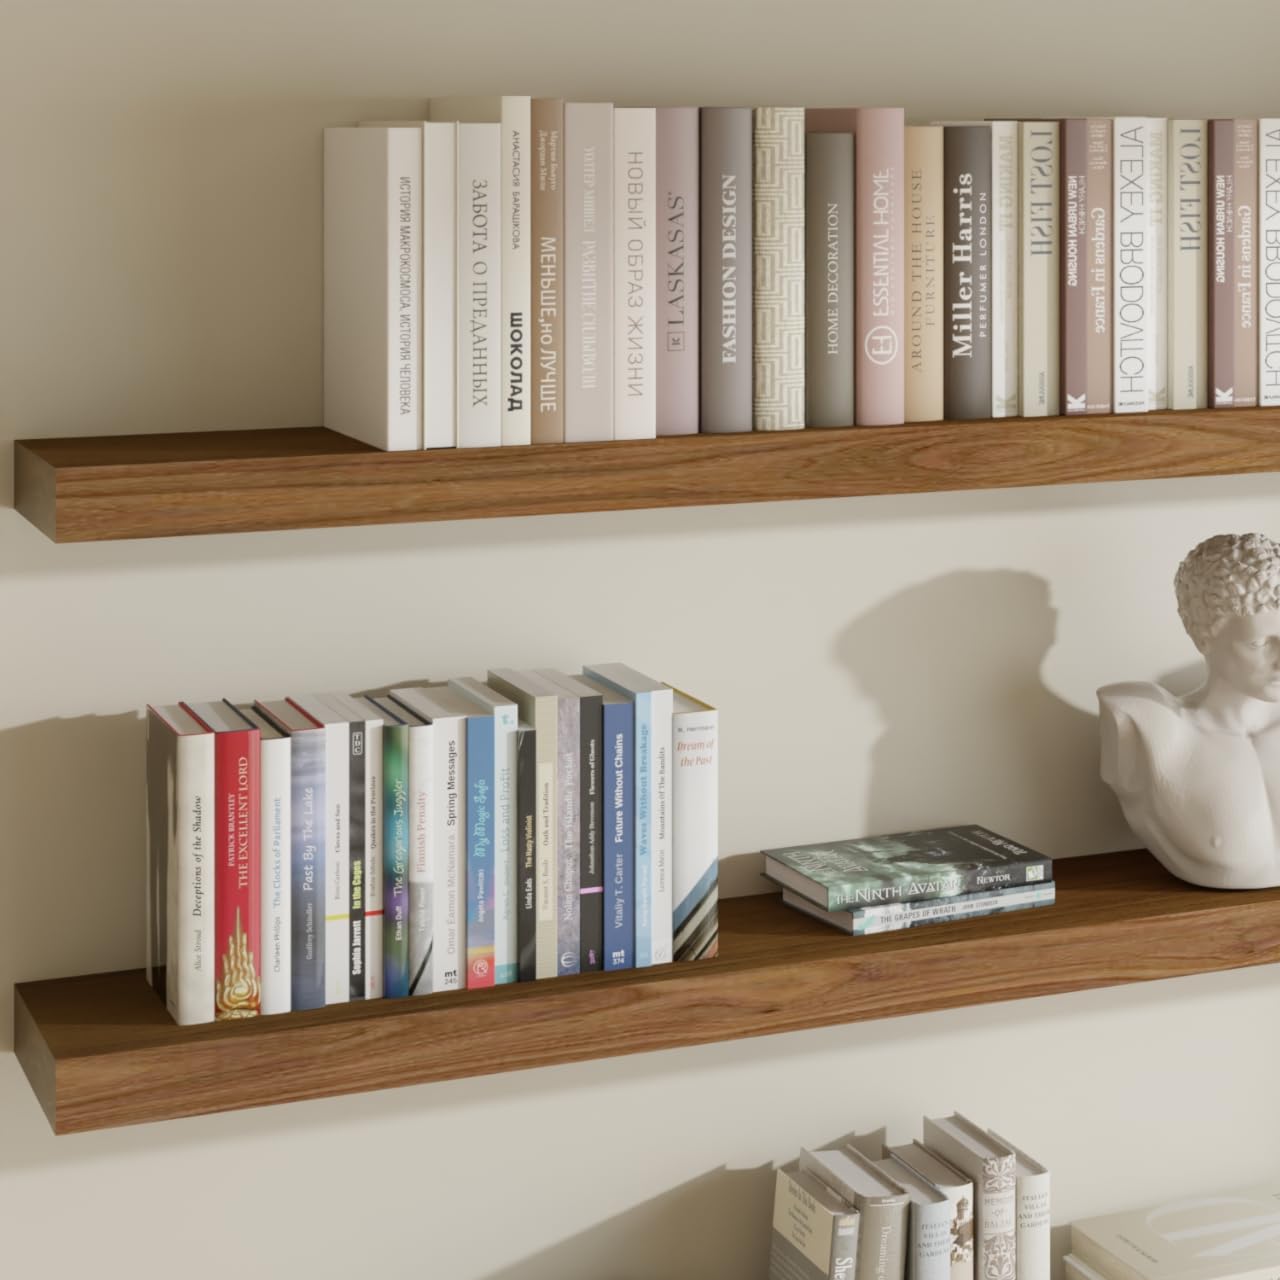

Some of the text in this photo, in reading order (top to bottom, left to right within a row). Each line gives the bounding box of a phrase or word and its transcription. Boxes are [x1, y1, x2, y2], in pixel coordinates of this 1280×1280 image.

[399, 176, 411, 222] ИСТОРИЯ
[512, 131, 520, 250] АНАСТАСИЯ БАРАШКОВА
[873, 168, 889, 316] ESSENTIAL HOME
[469, 179, 488, 407] ЗАБОТА О ПРЕДАННЫХ
[627, 152, 647, 397] НОВЫЙ ОБРАЗ ЖИЗНИ
[722, 174, 736, 363] FASHION DESIGN
[828, 203, 839, 354] HOME DECORATION
[911, 168, 923, 373] AROUND THE HOUSE
[925, 215, 935, 326] FURNITURE
[952, 173, 973, 358] Miller Harris
[979, 192, 987, 337] PERFUMER LONDON
[399, 314, 411, 360] ИСТОРИЯ
[399, 363, 411, 415] ЧЕЛОВЕКА
[508, 312, 523, 412] ШОКОЛАД
[238, 757, 248, 888] THE EXCELLENT LORD
[303, 787, 314, 891] Past By The Lake
[446, 741, 457, 826] Spring Messages
[614, 734, 624, 843] Future Without Chains
[192, 795, 204, 916] Deceptions of the Shadow
[855, 887, 902, 902] NINTH
[880, 914, 892, 924] THE
[895, 911, 920, 922] GRAPES
[922, 910, 930, 918] OF
